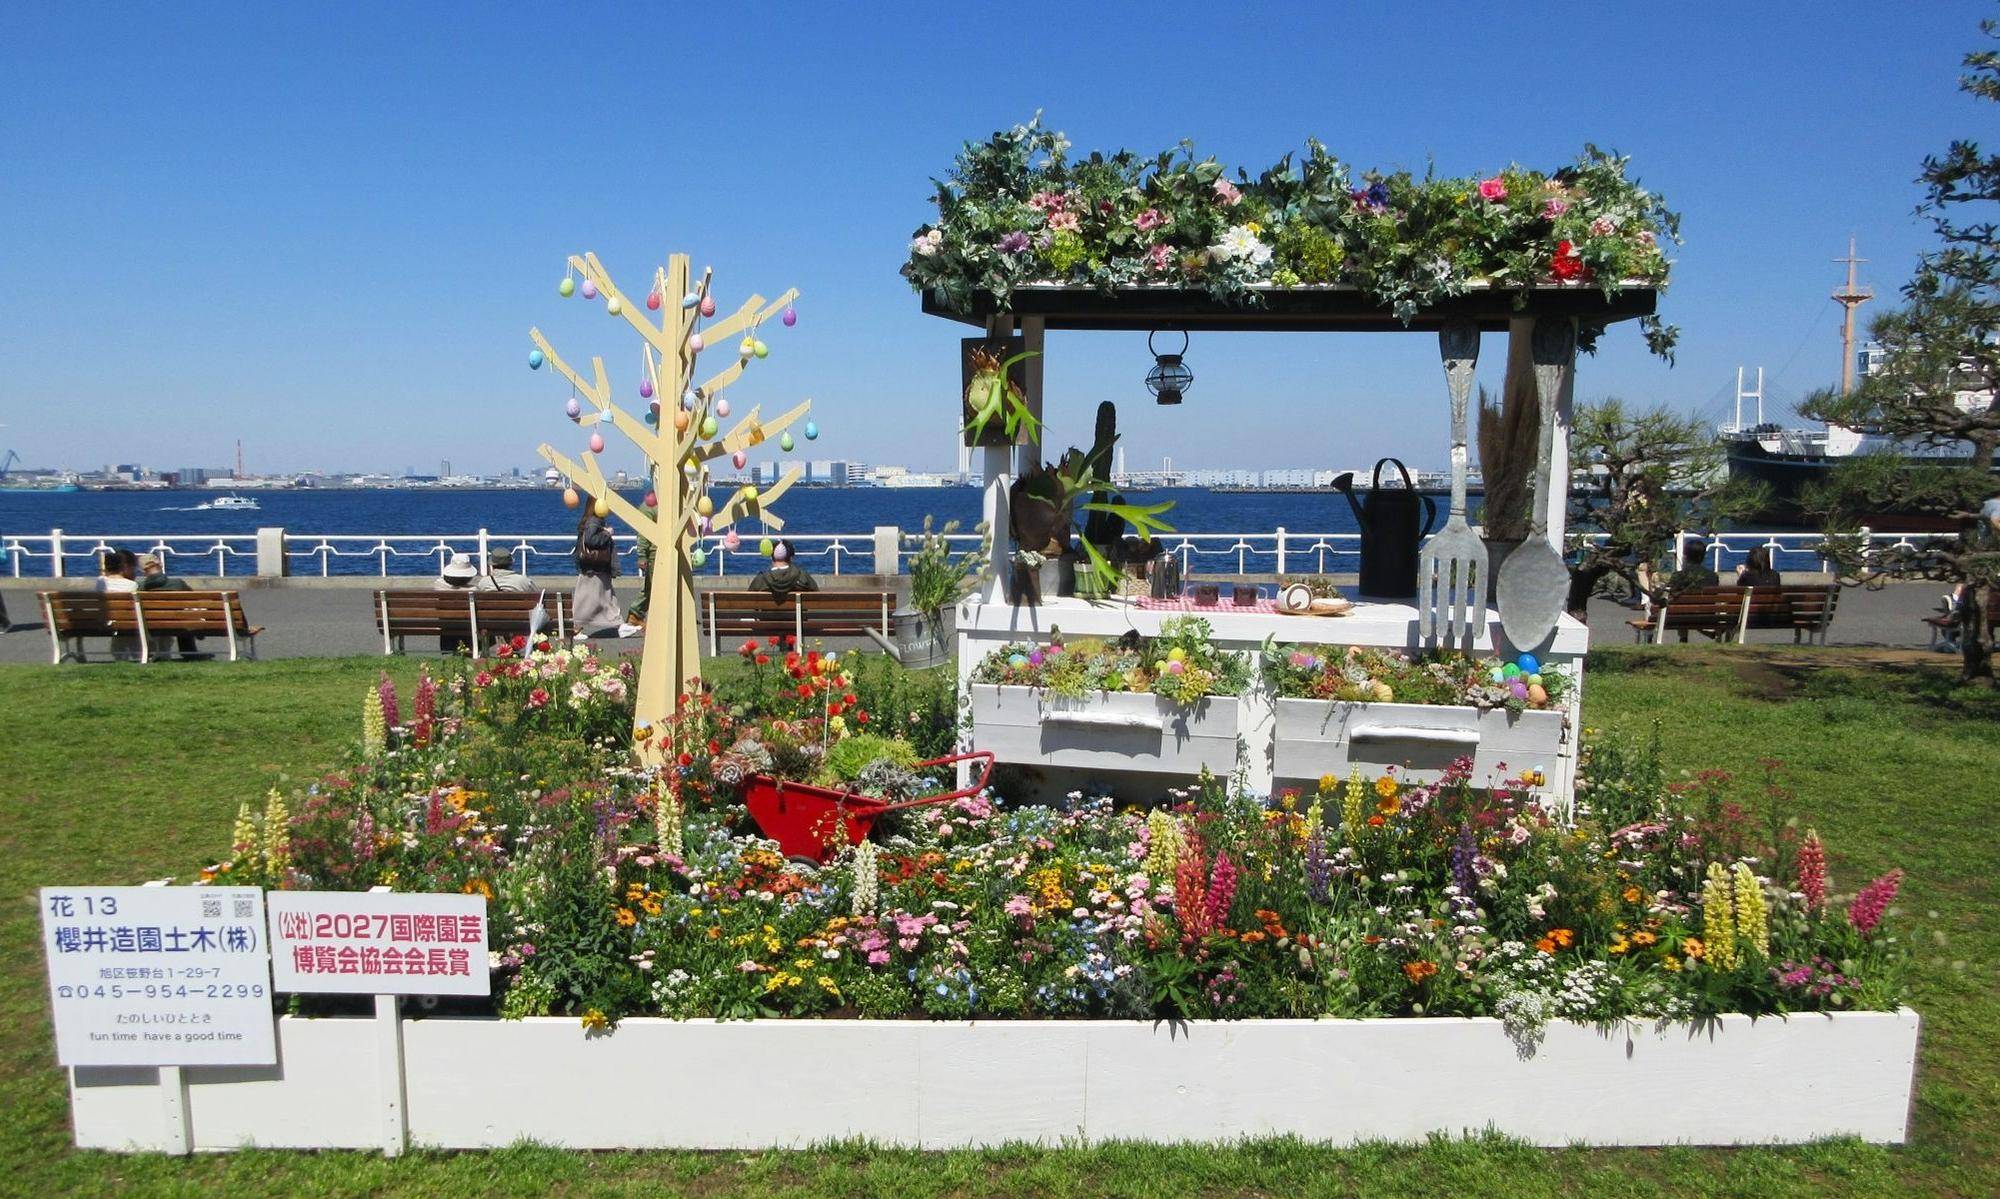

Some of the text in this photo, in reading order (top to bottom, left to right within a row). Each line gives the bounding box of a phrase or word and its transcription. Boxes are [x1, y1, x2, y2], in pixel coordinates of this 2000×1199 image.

[49, 896, 118, 917] 花 13
[278, 911, 482, 943] (公社)2027国際園芸
[55, 926, 257, 953] 櫻井造園土木(株)
[293, 945, 470, 977] 博覧会協会会長賞
[116, 1013, 212, 1024] たのしいひととき
[90, 1032, 243, 1043] fun time have a good time
